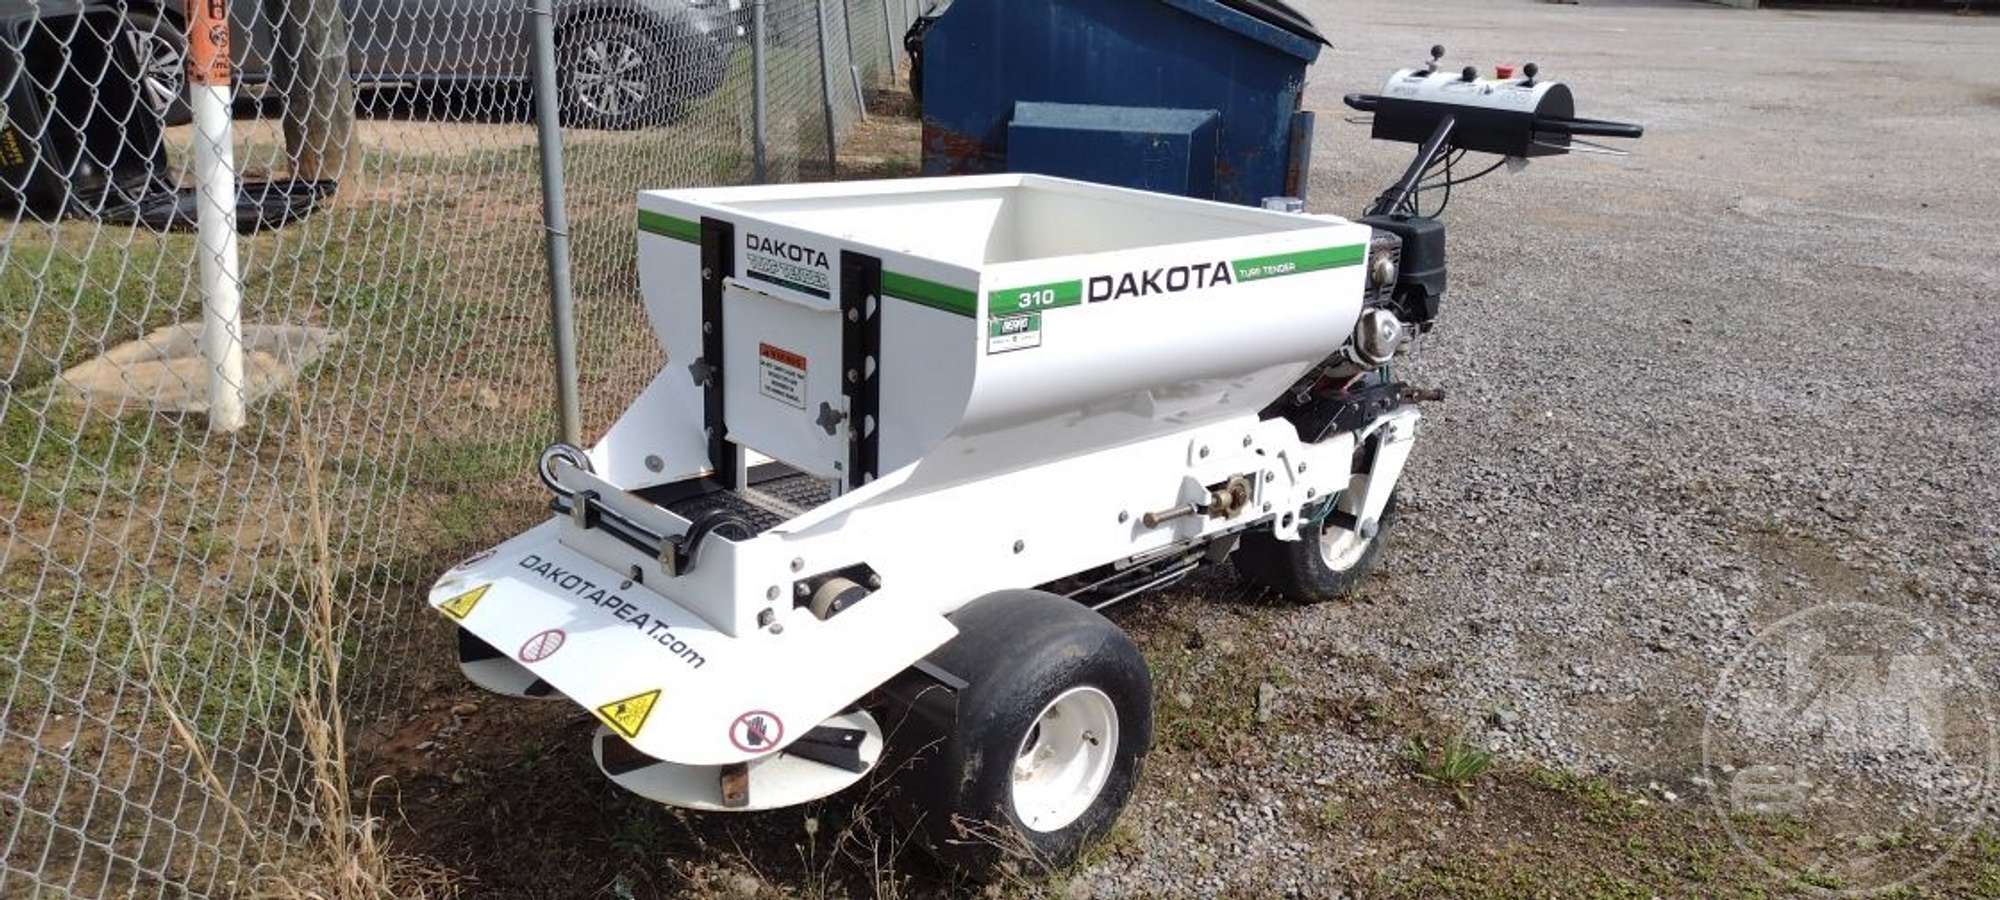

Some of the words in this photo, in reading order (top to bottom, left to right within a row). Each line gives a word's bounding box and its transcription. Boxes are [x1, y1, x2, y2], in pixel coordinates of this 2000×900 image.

[746, 232, 830, 270] DAKOTA
[1018, 289, 1055, 308] 310
[1088, 261, 1232, 303] DAKOTA
[519, 555, 706, 669] DAKOTAPEAT.com
